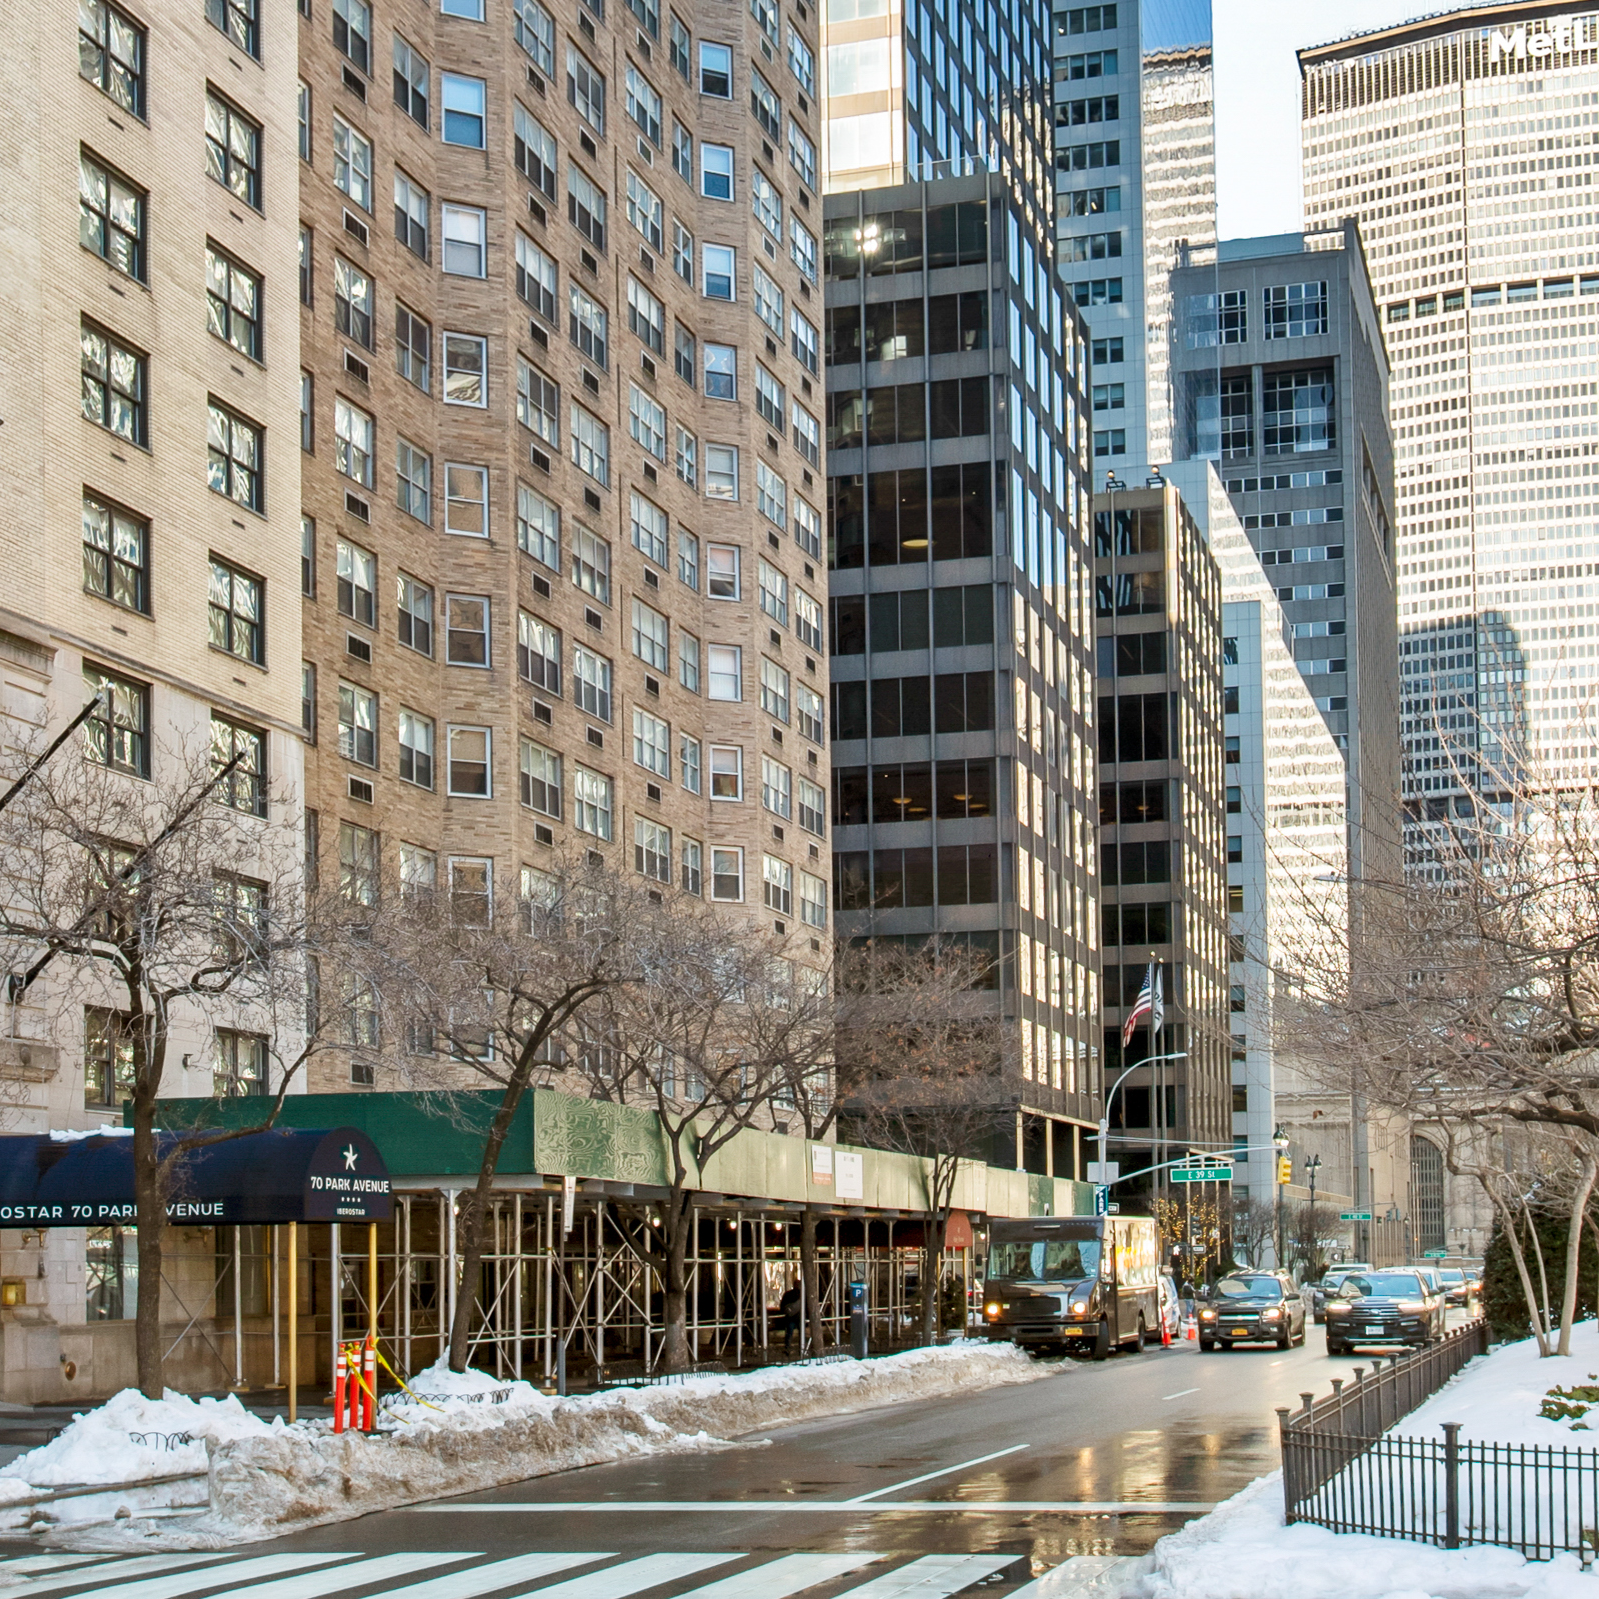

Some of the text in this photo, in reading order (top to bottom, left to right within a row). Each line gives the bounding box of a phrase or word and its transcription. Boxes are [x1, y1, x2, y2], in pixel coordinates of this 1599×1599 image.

[1188, 1171, 1193, 1179] E
[1196, 1170, 1205, 1179] 39
[310, 1176, 389, 1193] 70 PARK AVENUE
[71, 1205, 93, 1218] 70
[166, 1203, 224, 1217] VENUE
[336, 1207, 366, 1216] IBEROSTAR
[855, 1289, 862, 1297] P
